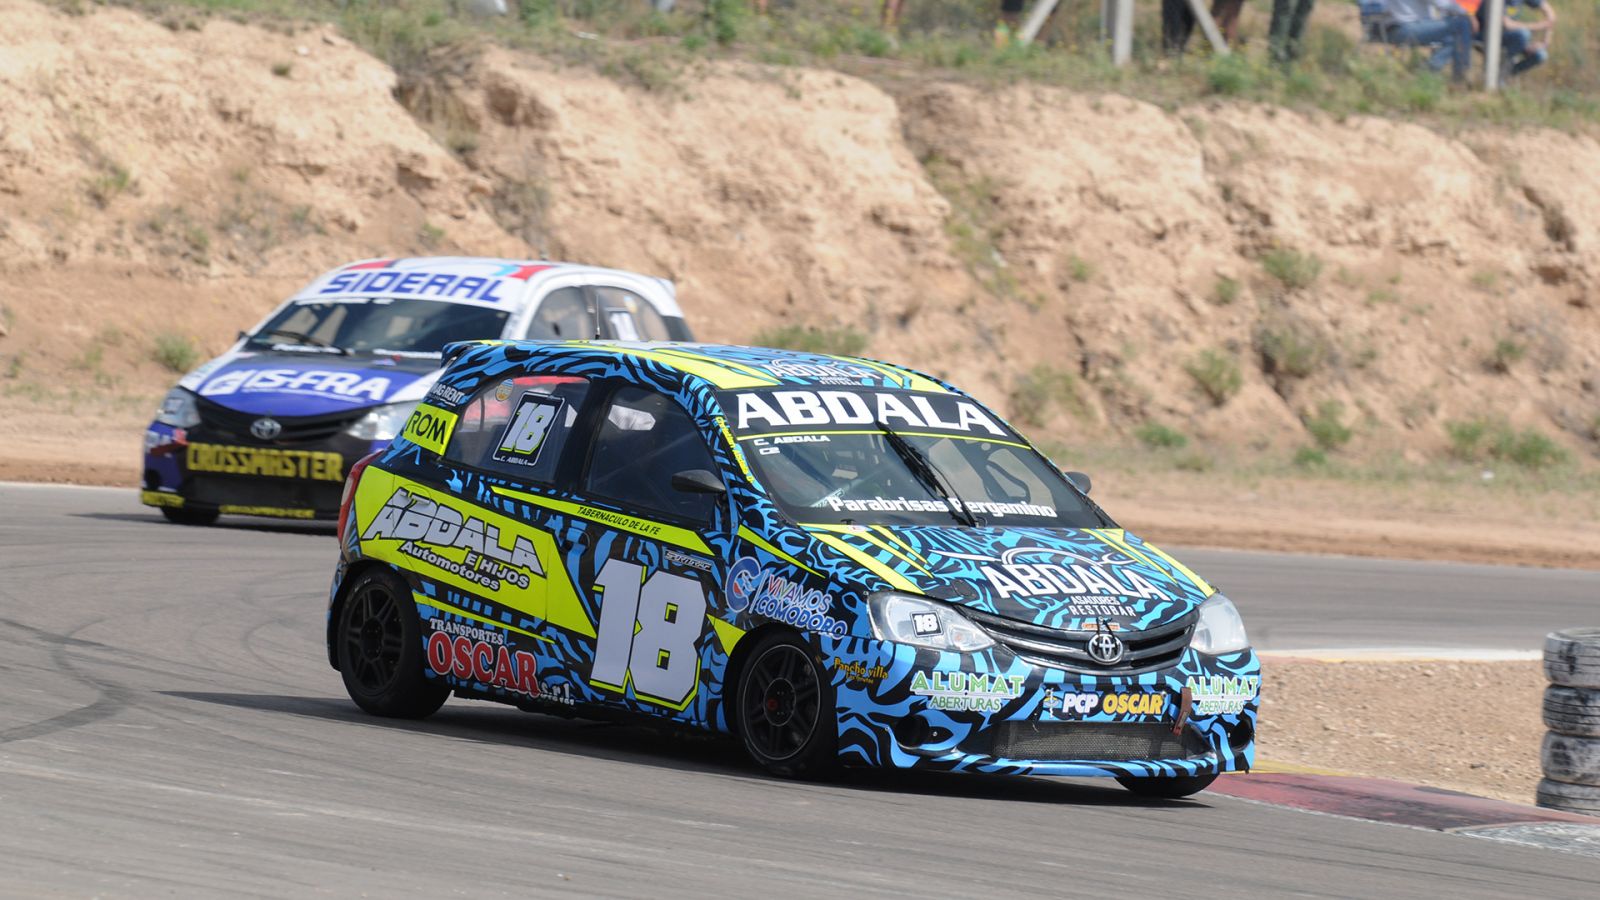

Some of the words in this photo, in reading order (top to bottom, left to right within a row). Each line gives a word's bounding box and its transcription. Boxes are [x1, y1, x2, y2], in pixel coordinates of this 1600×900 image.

[320, 271, 503, 302] SIDERAL
[736, 389, 1007, 436] ABDALA
[404, 410, 447, 446] ROM
[499, 401, 556, 455] 18
[773, 434, 831, 445] ABDALA
[576, 506, 630, 527] TABERNACULO
[627, 520, 639, 530] DE
[639, 524, 649, 533] LA
[648, 527, 662, 536] FE
[825, 496, 949, 513] Parabrisas
[947, 497, 1058, 518] Pergamino
[360, 486, 547, 579] ABDALA
[400, 541, 502, 594] Automotores
[465, 551, 478, 568] E
[479, 559, 531, 591] HIJOS
[979, 563, 1172, 602] ABDALA
[766, 573, 833, 615] VIVAMOS
[756, 595, 848, 640] COMODORO
[913, 613, 939, 633] 18
[1067, 604, 1137, 618] RESTOBAR
[429, 617, 504, 645] TRANSPORTES
[591, 557, 706, 710] 18
[427, 630, 541, 699] OSCAR
[833, 656, 866, 675] Pancho
[909, 670, 1025, 696] ALUMAT
[1185, 674, 1259, 697] ALUMAT
[929, 695, 1002, 713] ABERTURAS
[1062, 692, 1099, 714] PCP
[1102, 691, 1167, 716] OSCAR
[1198, 698, 1246, 714] ABERTURAS
